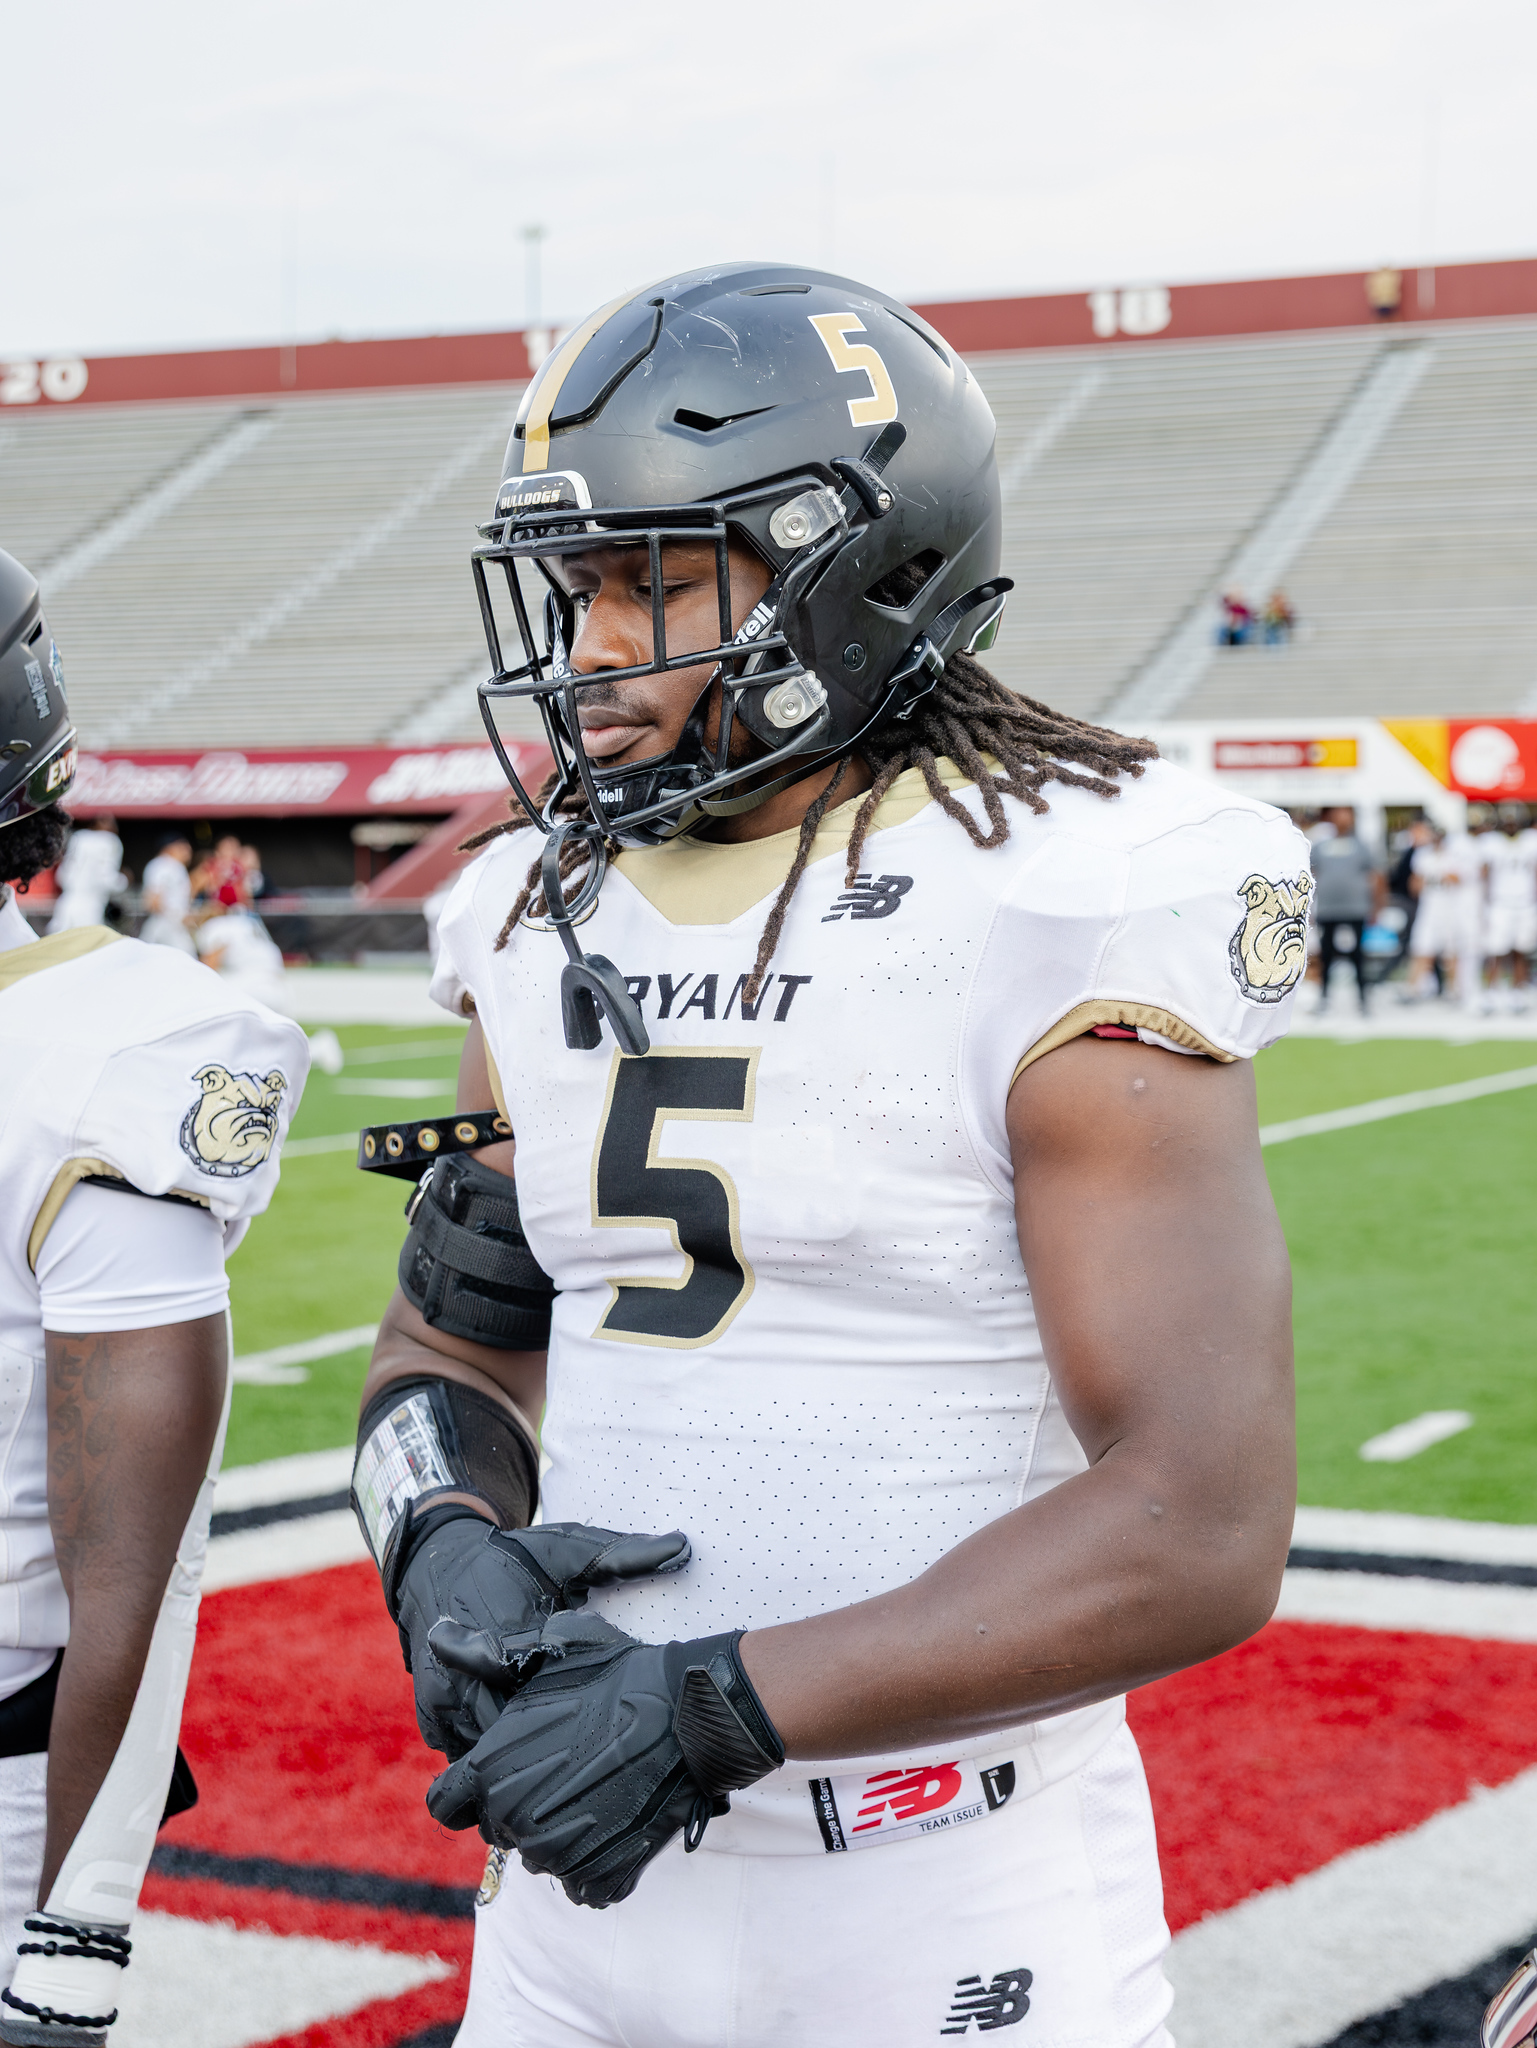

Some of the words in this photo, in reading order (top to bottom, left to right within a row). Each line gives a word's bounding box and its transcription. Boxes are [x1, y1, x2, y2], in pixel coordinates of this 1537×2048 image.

[1088, 288, 1171, 338] 18
[0, 360, 89, 404] 20
[807, 312, 898, 427] 5
[500, 489, 561, 510] BULLDOGS
[595, 973, 814, 1022] RYANT
[591, 1046, 763, 1350] 5
[823, 1802, 835, 1820] the
[990, 1777, 1007, 1805] L
[919, 1816, 951, 1833] TEAM
[953, 1805, 984, 1824] ISSUE
